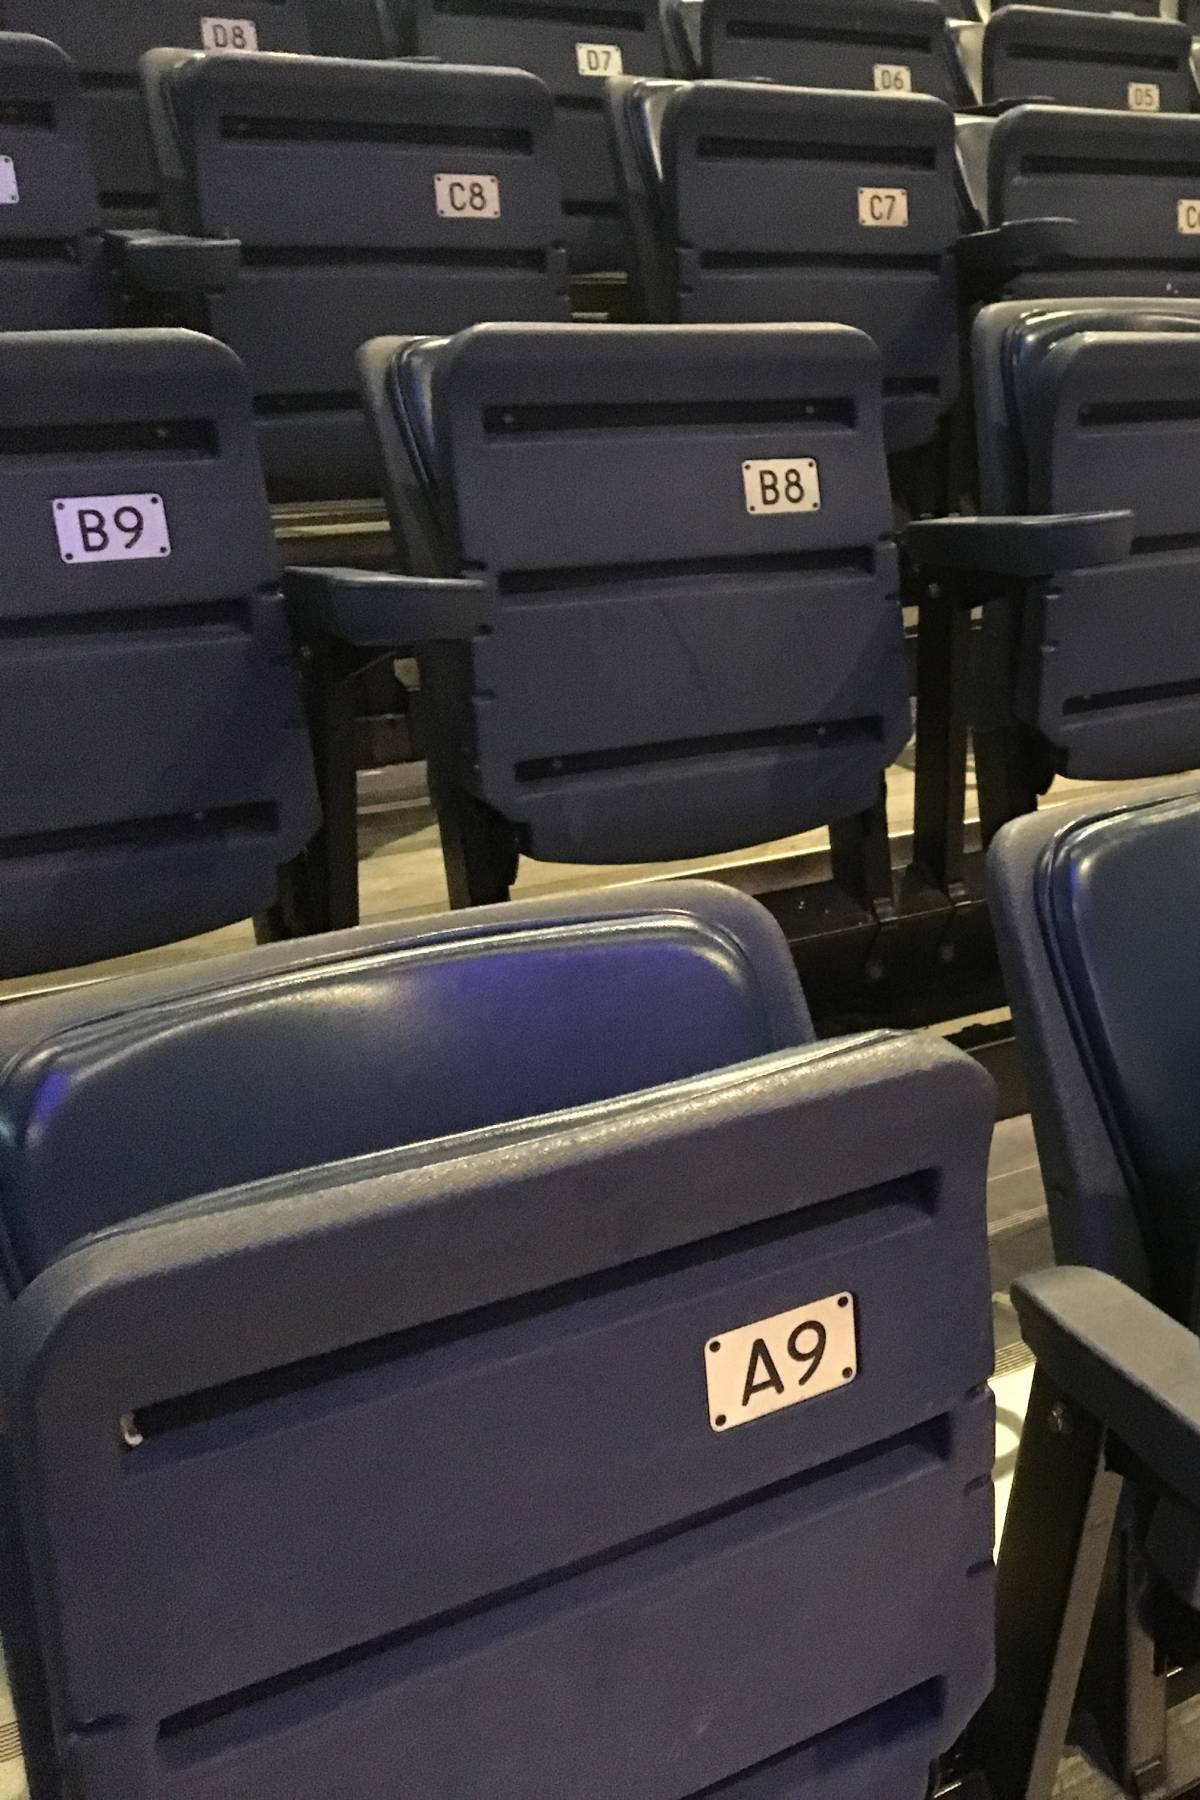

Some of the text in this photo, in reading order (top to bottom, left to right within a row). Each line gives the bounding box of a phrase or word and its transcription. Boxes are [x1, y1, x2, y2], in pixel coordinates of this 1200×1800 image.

[212, 24, 246, 49] D8
[587, 50, 611, 71] D7
[881, 70, 904, 89] D6
[1135, 88, 1153, 106] D5
[449, 183, 486, 211] C8
[870, 195, 895, 220] C7
[759, 469, 804, 505] B8
[77, 506, 143, 552] B9
[742, 1320, 828, 1406] A9
